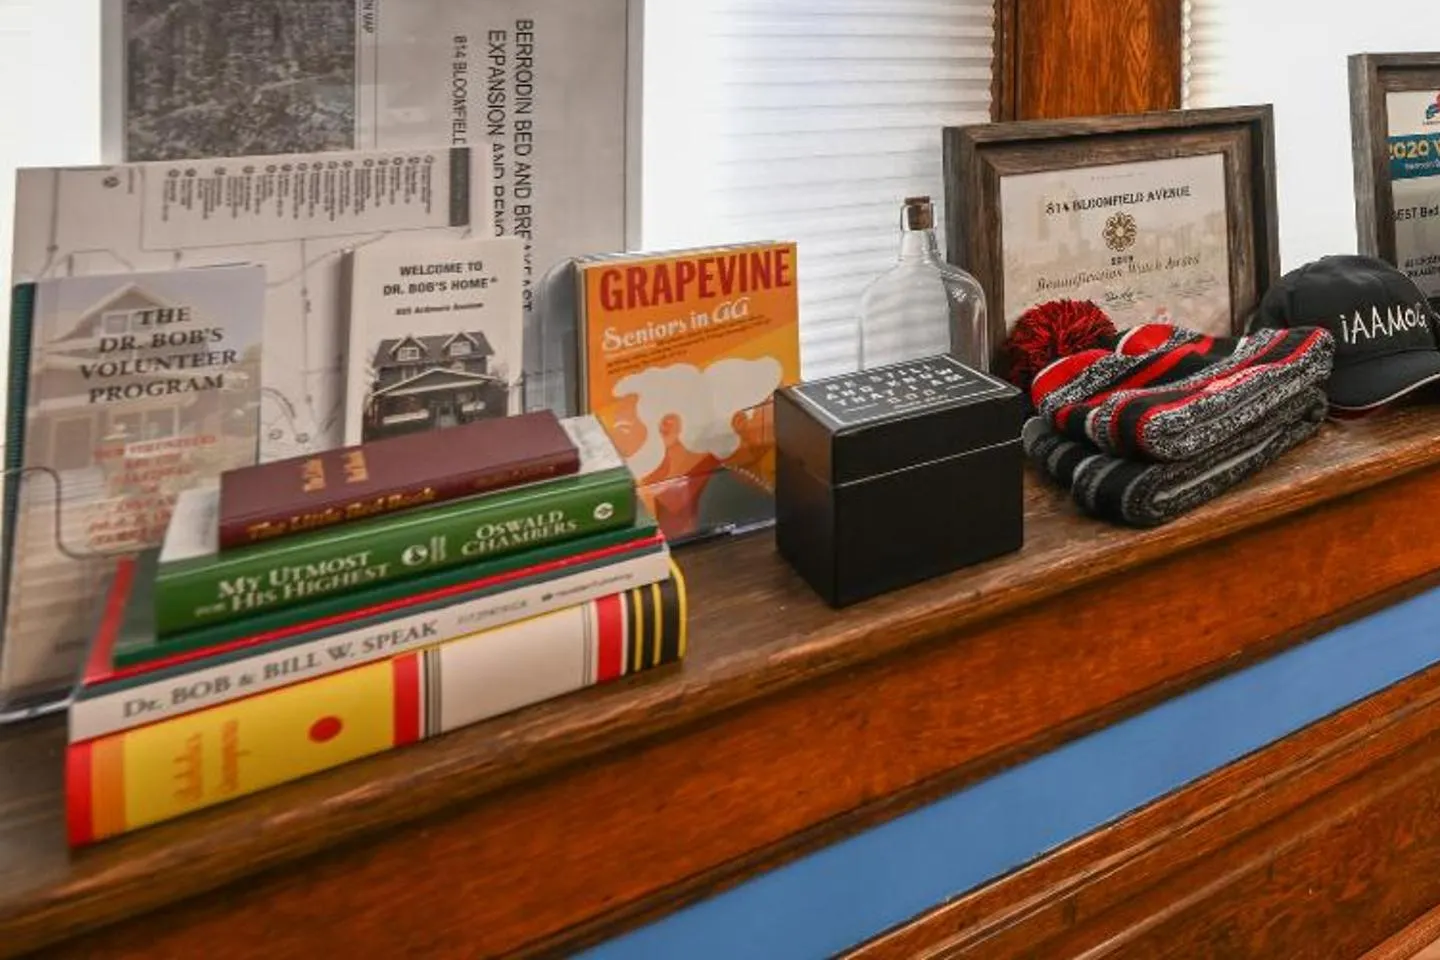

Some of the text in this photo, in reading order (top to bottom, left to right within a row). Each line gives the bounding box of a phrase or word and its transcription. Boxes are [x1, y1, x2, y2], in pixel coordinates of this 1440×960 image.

[486, 29, 507, 137] EXPANSION
[514, 19, 535, 114] BERRODIN
[513, 119, 533, 157] BED
[513, 161, 533, 200] AND
[1146, 185, 1192, 203] AVENUE
[399, 261, 483, 276] WELCOME TO
[600, 248, 793, 313] GRAPEVINE
[136, 306, 192, 327] THE
[602, 319, 688, 351] Seniors
[690, 310, 710, 329] in
[100, 327, 224, 354] DR. BOB'S
[80, 349, 237, 381] VOLUNTEER
[88, 373, 225, 404] PROGRAM
[460, 520, 578, 557] CHAMBERS
[475, 510, 566, 541] OSWALD
[268, 550, 372, 587] UTMOST
[283, 563, 391, 601] HIGHEST
[122, 697, 164, 720] Dr.
[171, 675, 232, 706] BOB
[262, 652, 324, 682] BILL
[328, 643, 355, 663] W.
[360, 619, 439, 654] SPEAK
